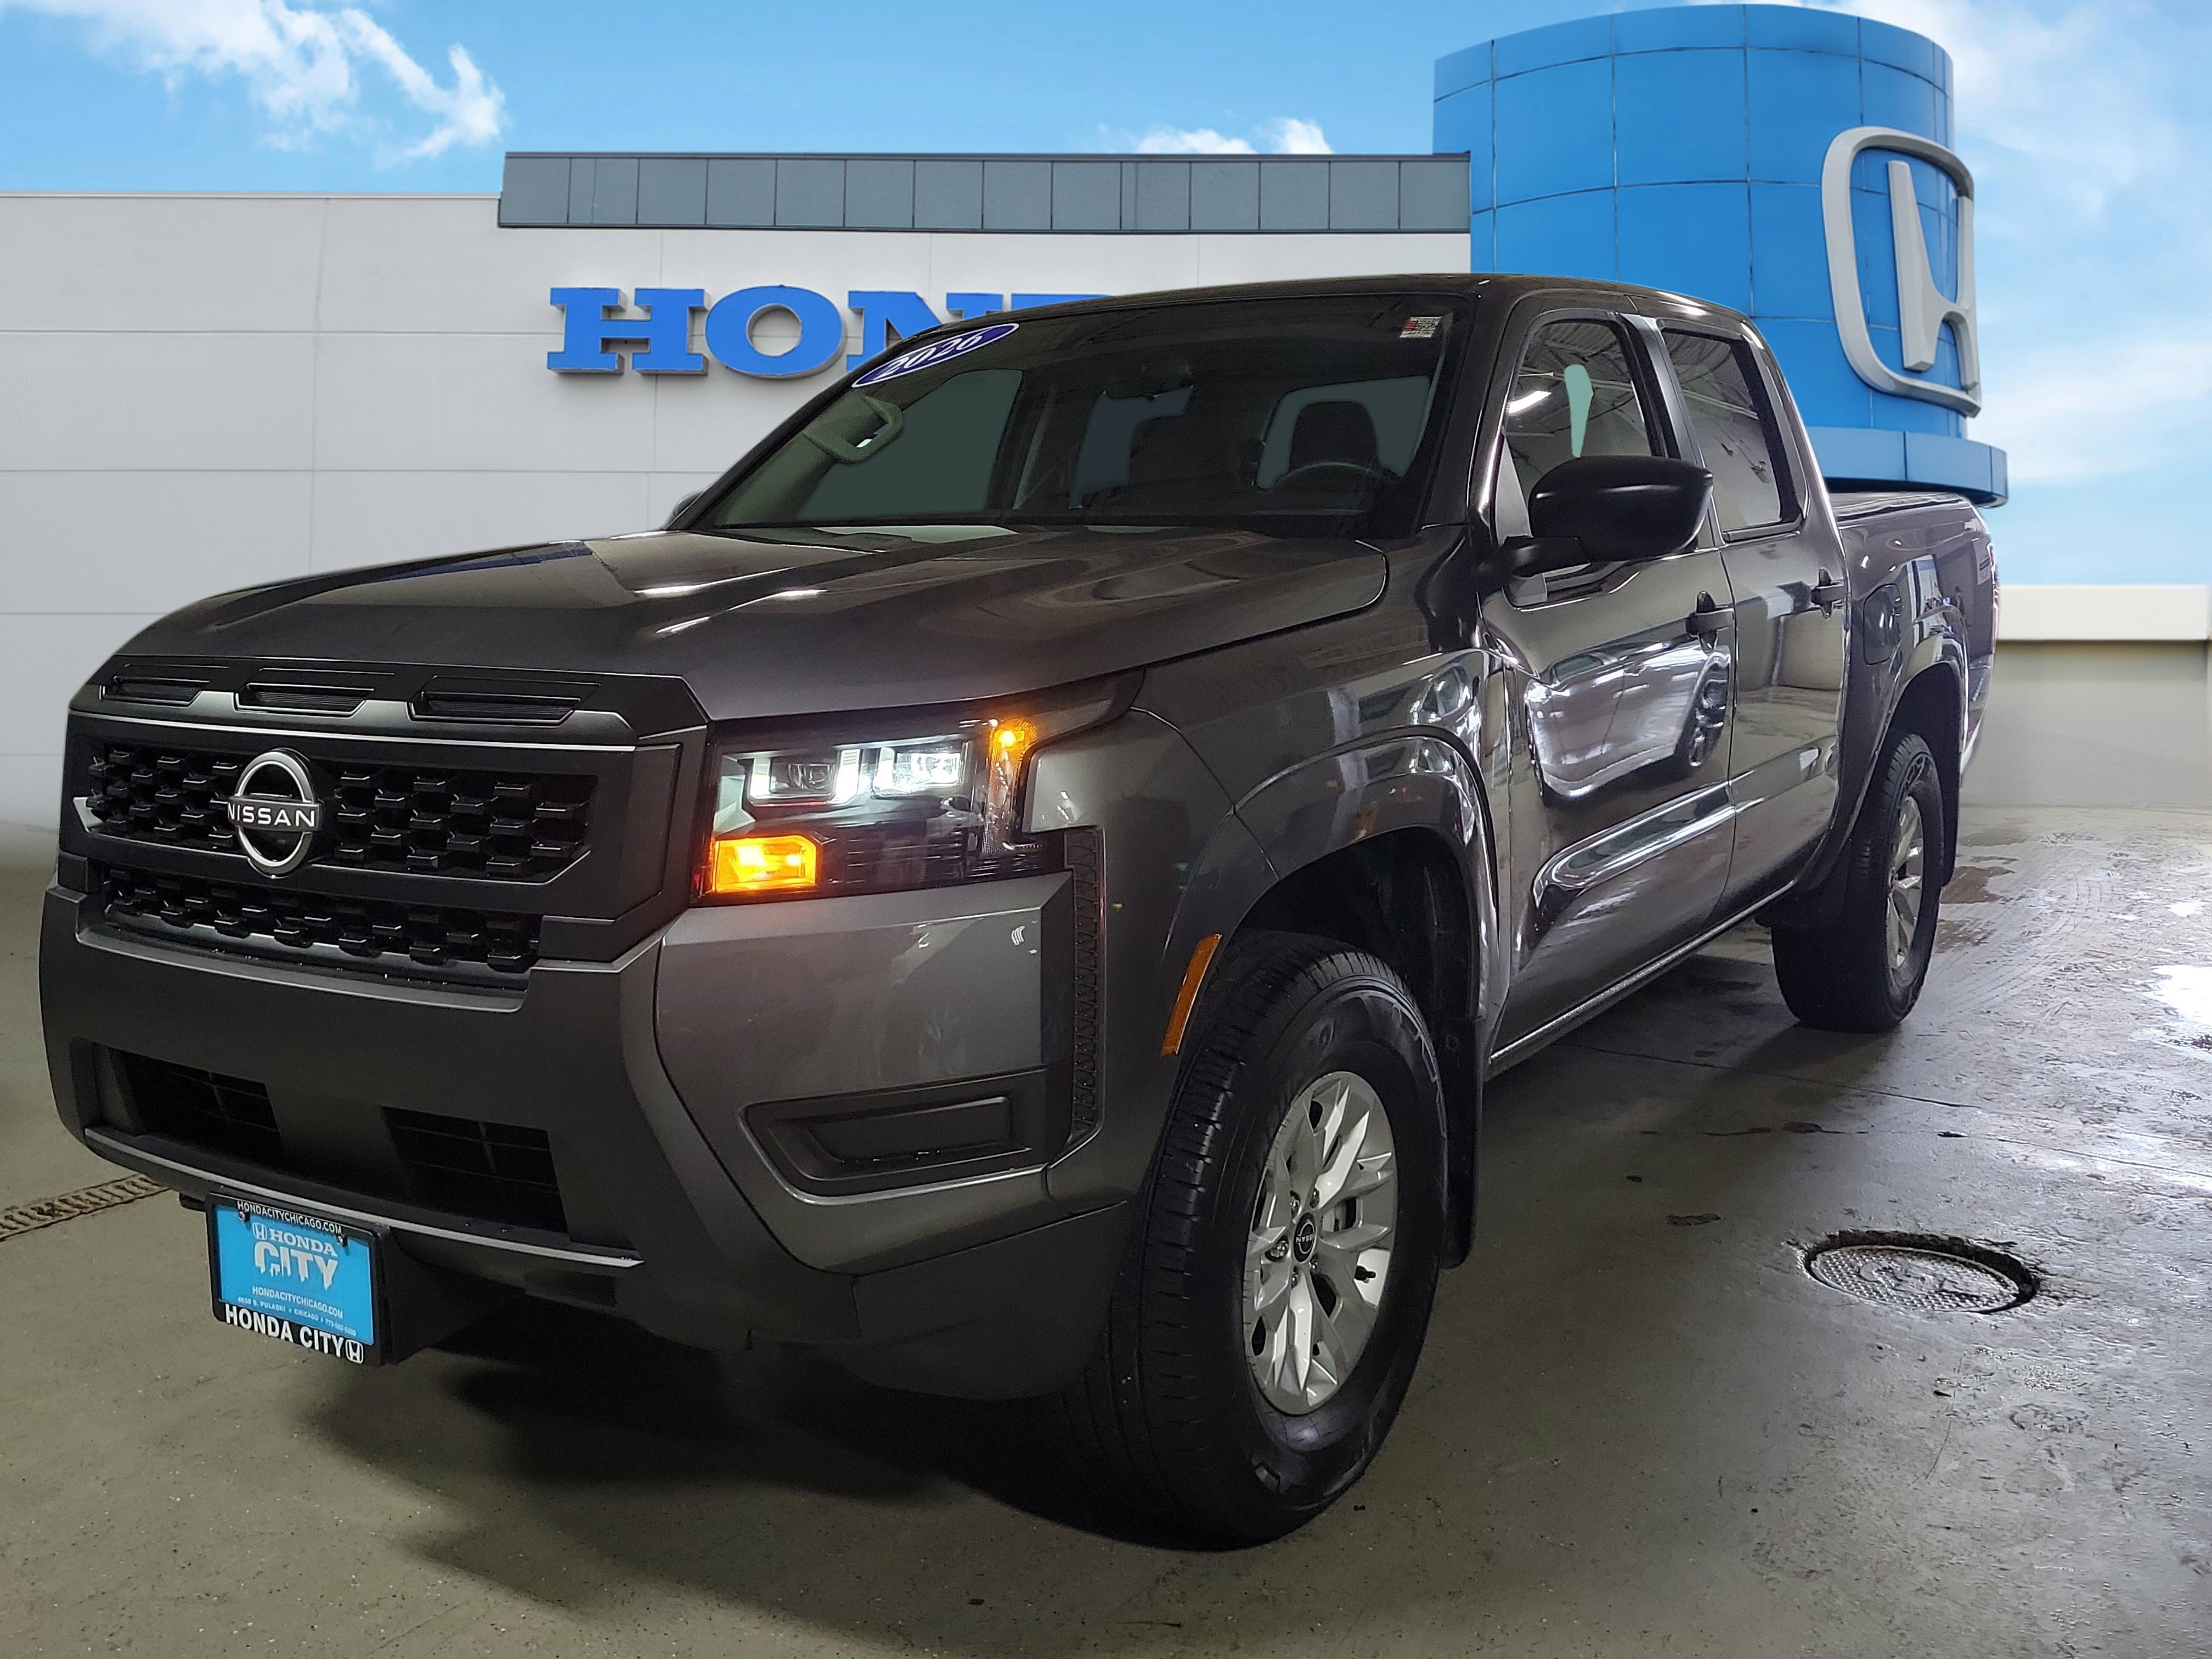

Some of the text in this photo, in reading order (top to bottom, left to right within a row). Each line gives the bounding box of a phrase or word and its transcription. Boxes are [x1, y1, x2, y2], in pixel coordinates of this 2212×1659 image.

[548, 285, 1119, 379] HON
[872, 328, 994, 380] 2026
[228, 802, 315, 827] NISSAN
[237, 1200, 343, 1234] HONDACITYCHICAGO.COM
[268, 1228, 338, 1257] HONDA
[254, 1241, 339, 1290] CITY
[252, 1285, 343, 1319] HONDACITYCHICAGO.COM
[225, 1303, 344, 1358] HONDA CITY
